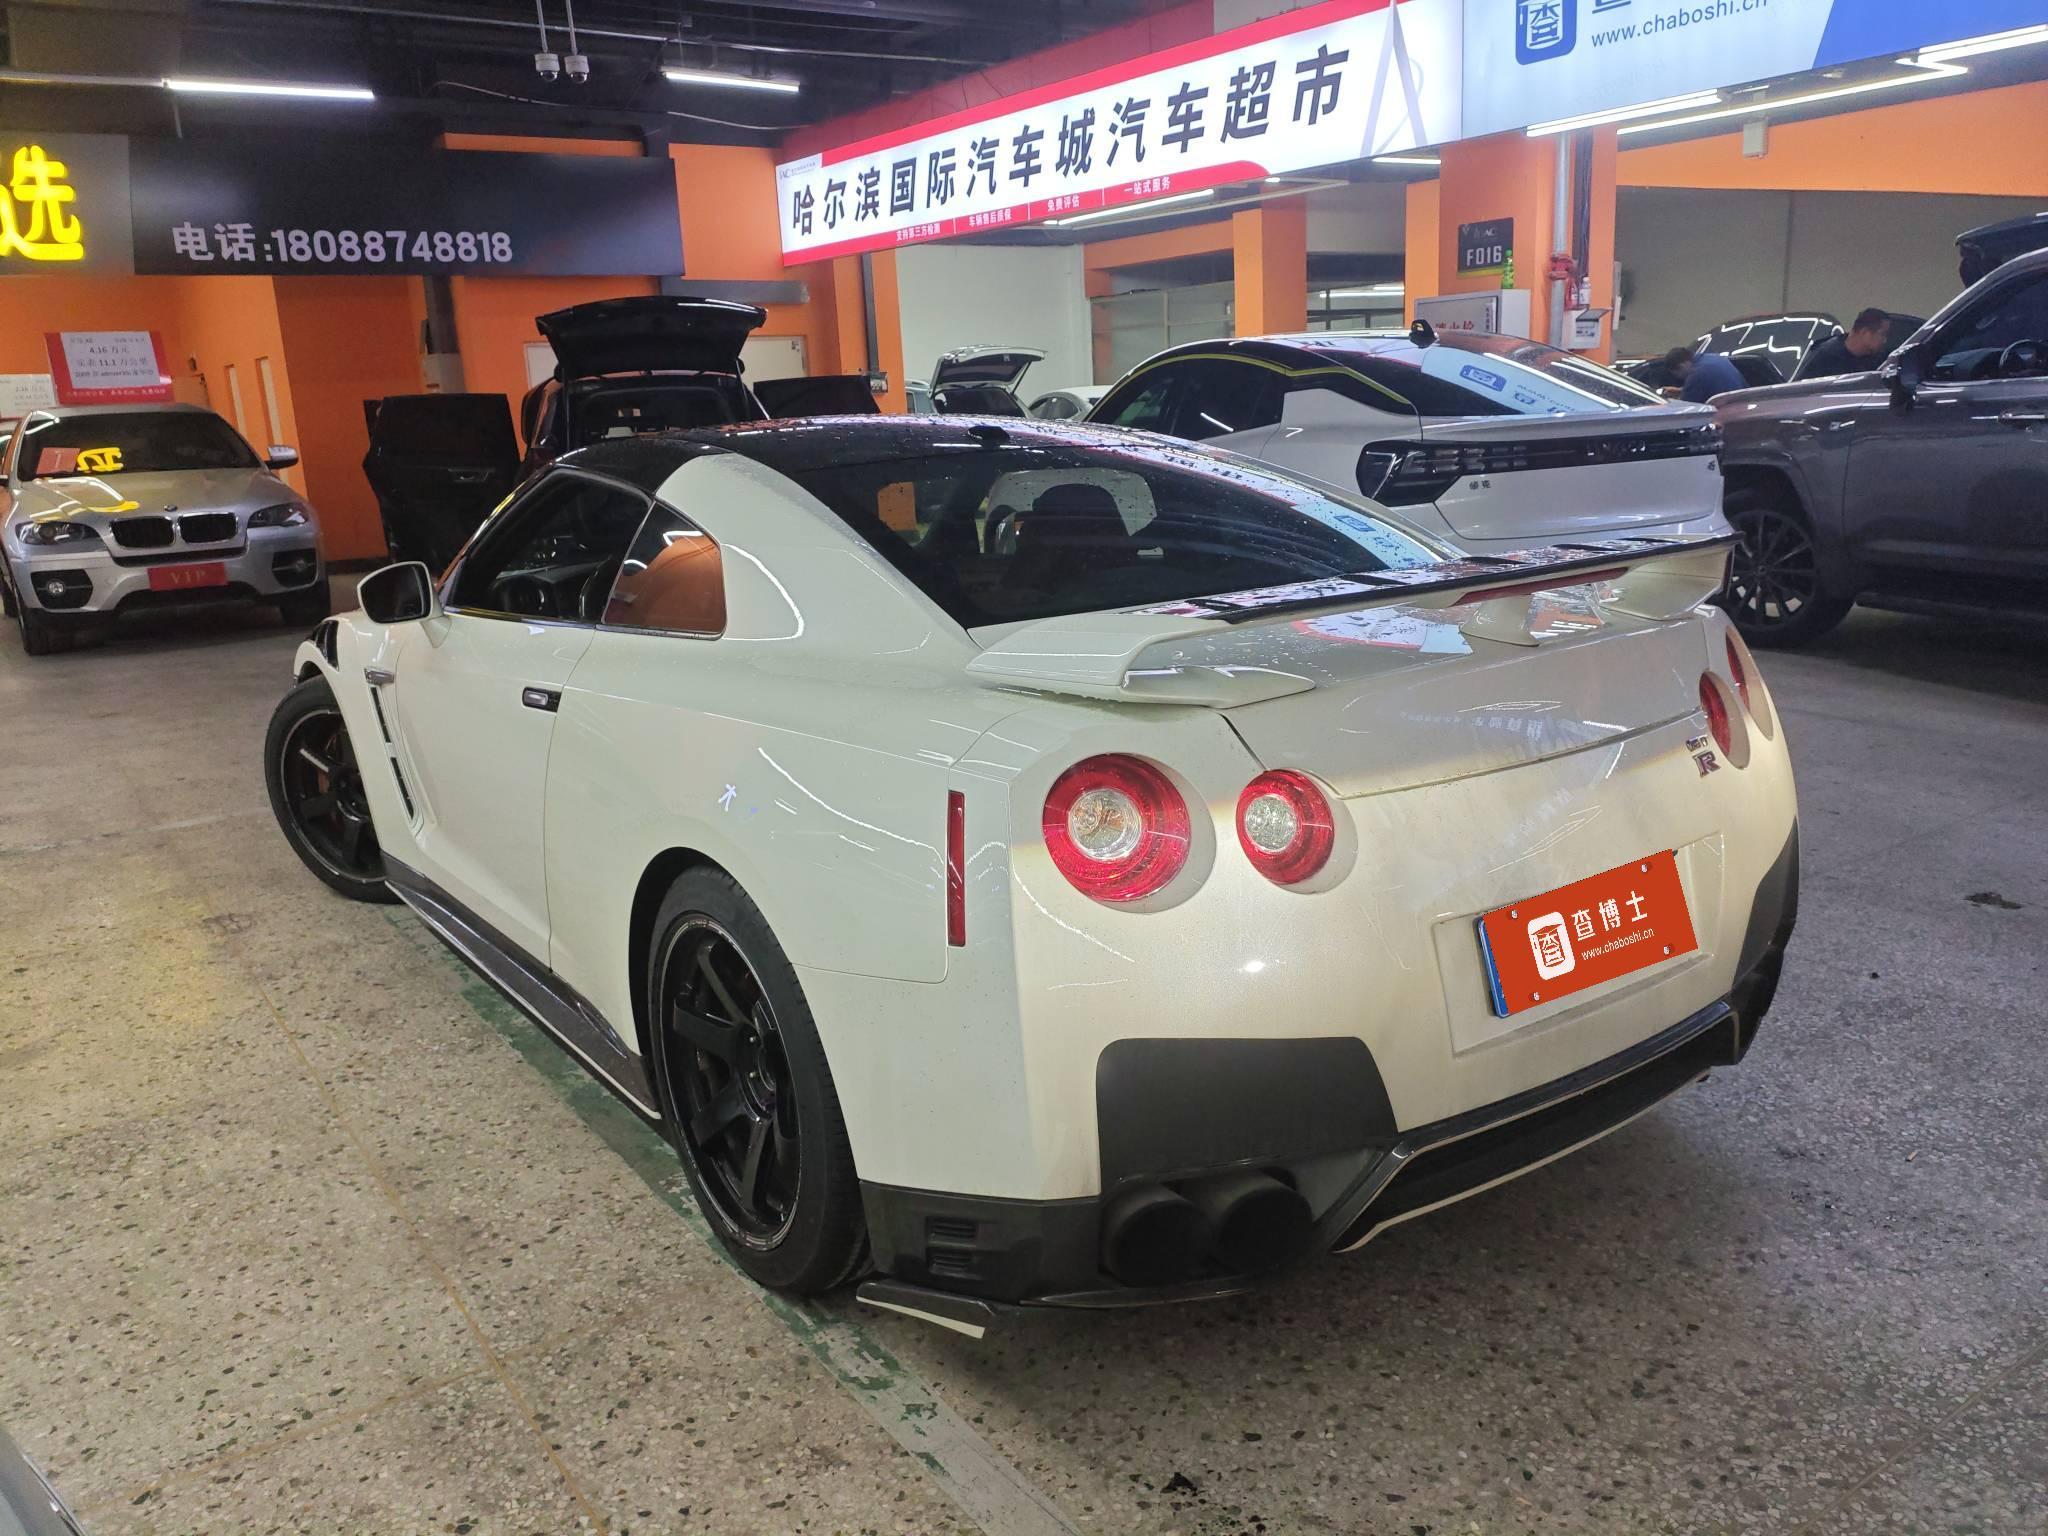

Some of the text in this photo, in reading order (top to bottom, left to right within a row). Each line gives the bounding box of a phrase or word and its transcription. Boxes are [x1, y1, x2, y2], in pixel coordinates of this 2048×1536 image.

[792, 43, 1350, 237] 哈尔滨国际汽车城汽车超市
[1124, 176, 1171, 195] 一站式服务
[1047, 195, 1079, 212] 免费评估
[968, 208, 1012, 228] 车辆售后质保
[172, 221, 513, 263] 电话:18088748818
[896, 223, 941, 242] 支持第三方检测
[1465, 245, 1503, 267] F016
[169, 569, 207, 585] VIP
